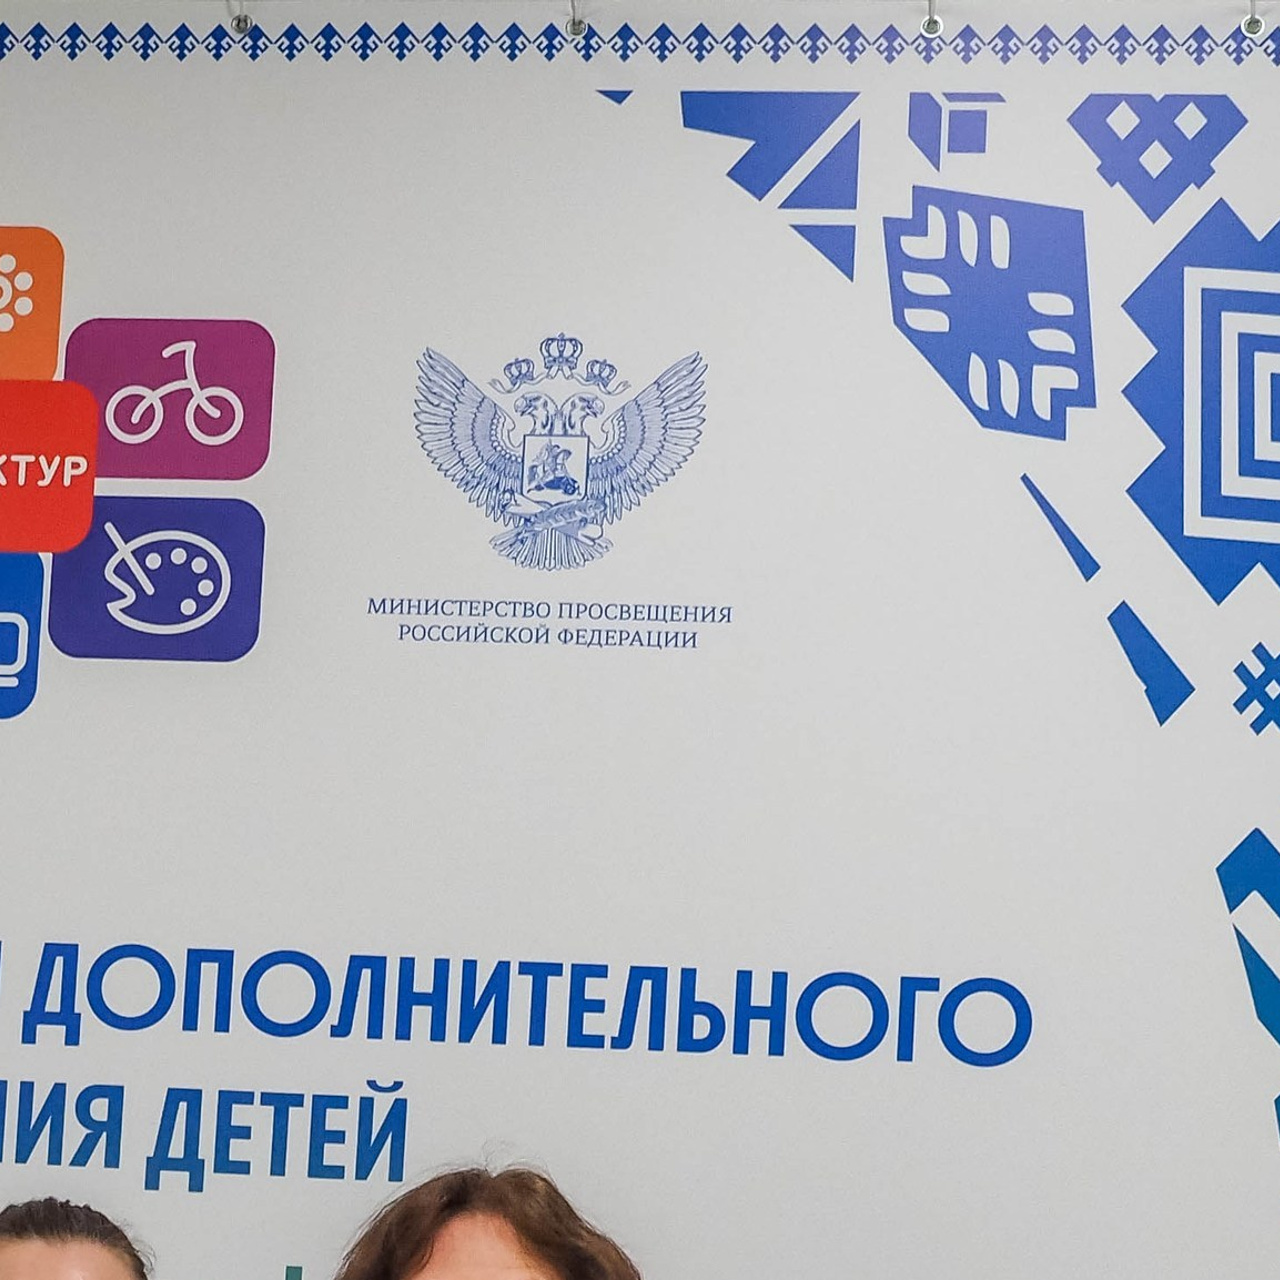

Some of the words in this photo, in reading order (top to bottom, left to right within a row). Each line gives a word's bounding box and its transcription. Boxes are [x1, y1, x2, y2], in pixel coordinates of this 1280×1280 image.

[367, 597, 551, 620] МИНИСТЕРСТВО
[558, 602, 733, 624] ПРОСВЕЩЕНИЯ
[398, 623, 549, 644] РОССИЙСКОЙ
[558, 628, 698, 649] ФЕДЕРАЦИИ
[21, 941, 1033, 1068] ДОПОЛНИТЕЛЬНОГО
[145, 1080, 409, 1193] ДЕТЕЙ
